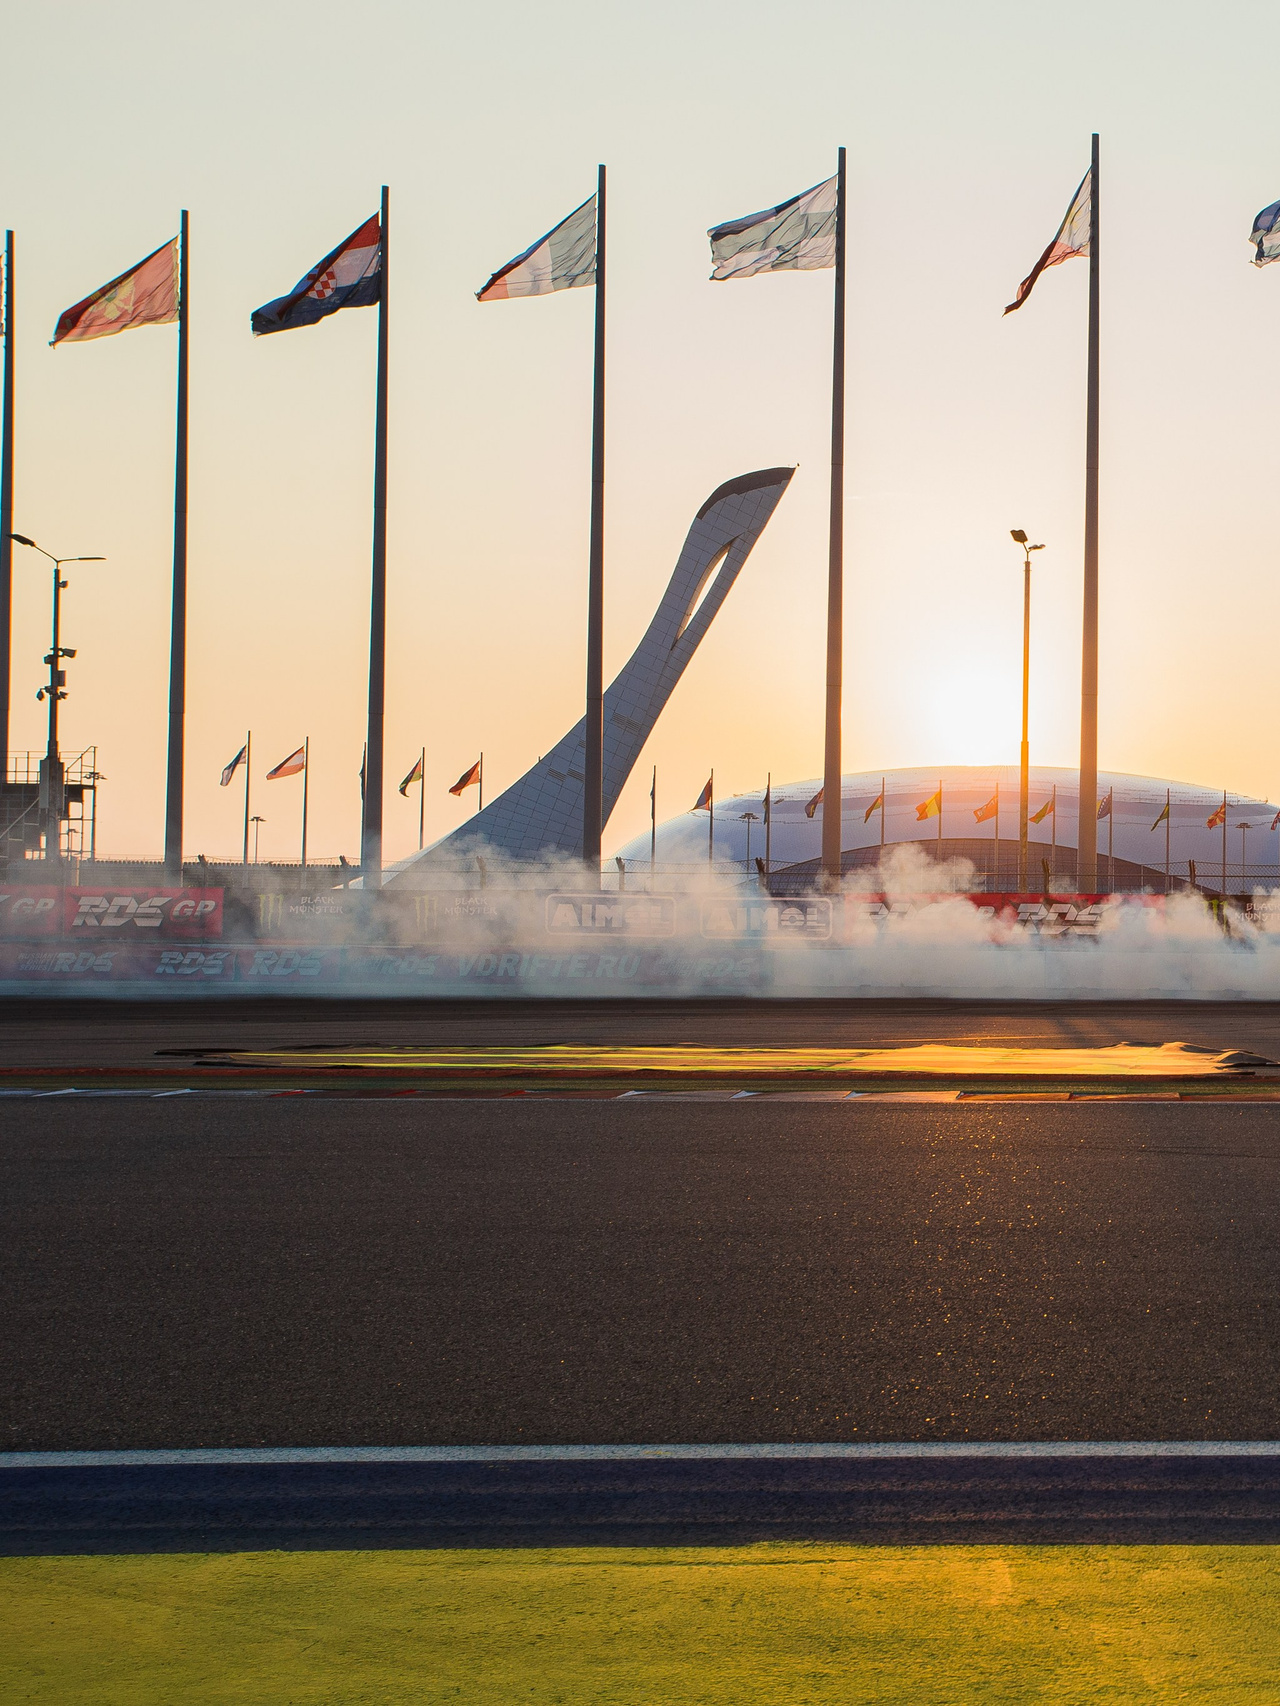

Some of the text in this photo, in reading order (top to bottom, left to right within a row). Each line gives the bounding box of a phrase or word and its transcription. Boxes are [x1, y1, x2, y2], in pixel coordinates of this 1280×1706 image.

[72, 896, 216, 927] RDS GP
[289, 904, 344, 915] MONSTER
[301, 896, 335, 905] BLACK
[551, 903, 670, 929] AIMOL
[706, 907, 826, 931] AIMOL
[1011, 903, 1114, 935] RDS
[53, 951, 118, 973] RDS
[155, 951, 230, 975] RDS
[248, 951, 328, 976] RDS
